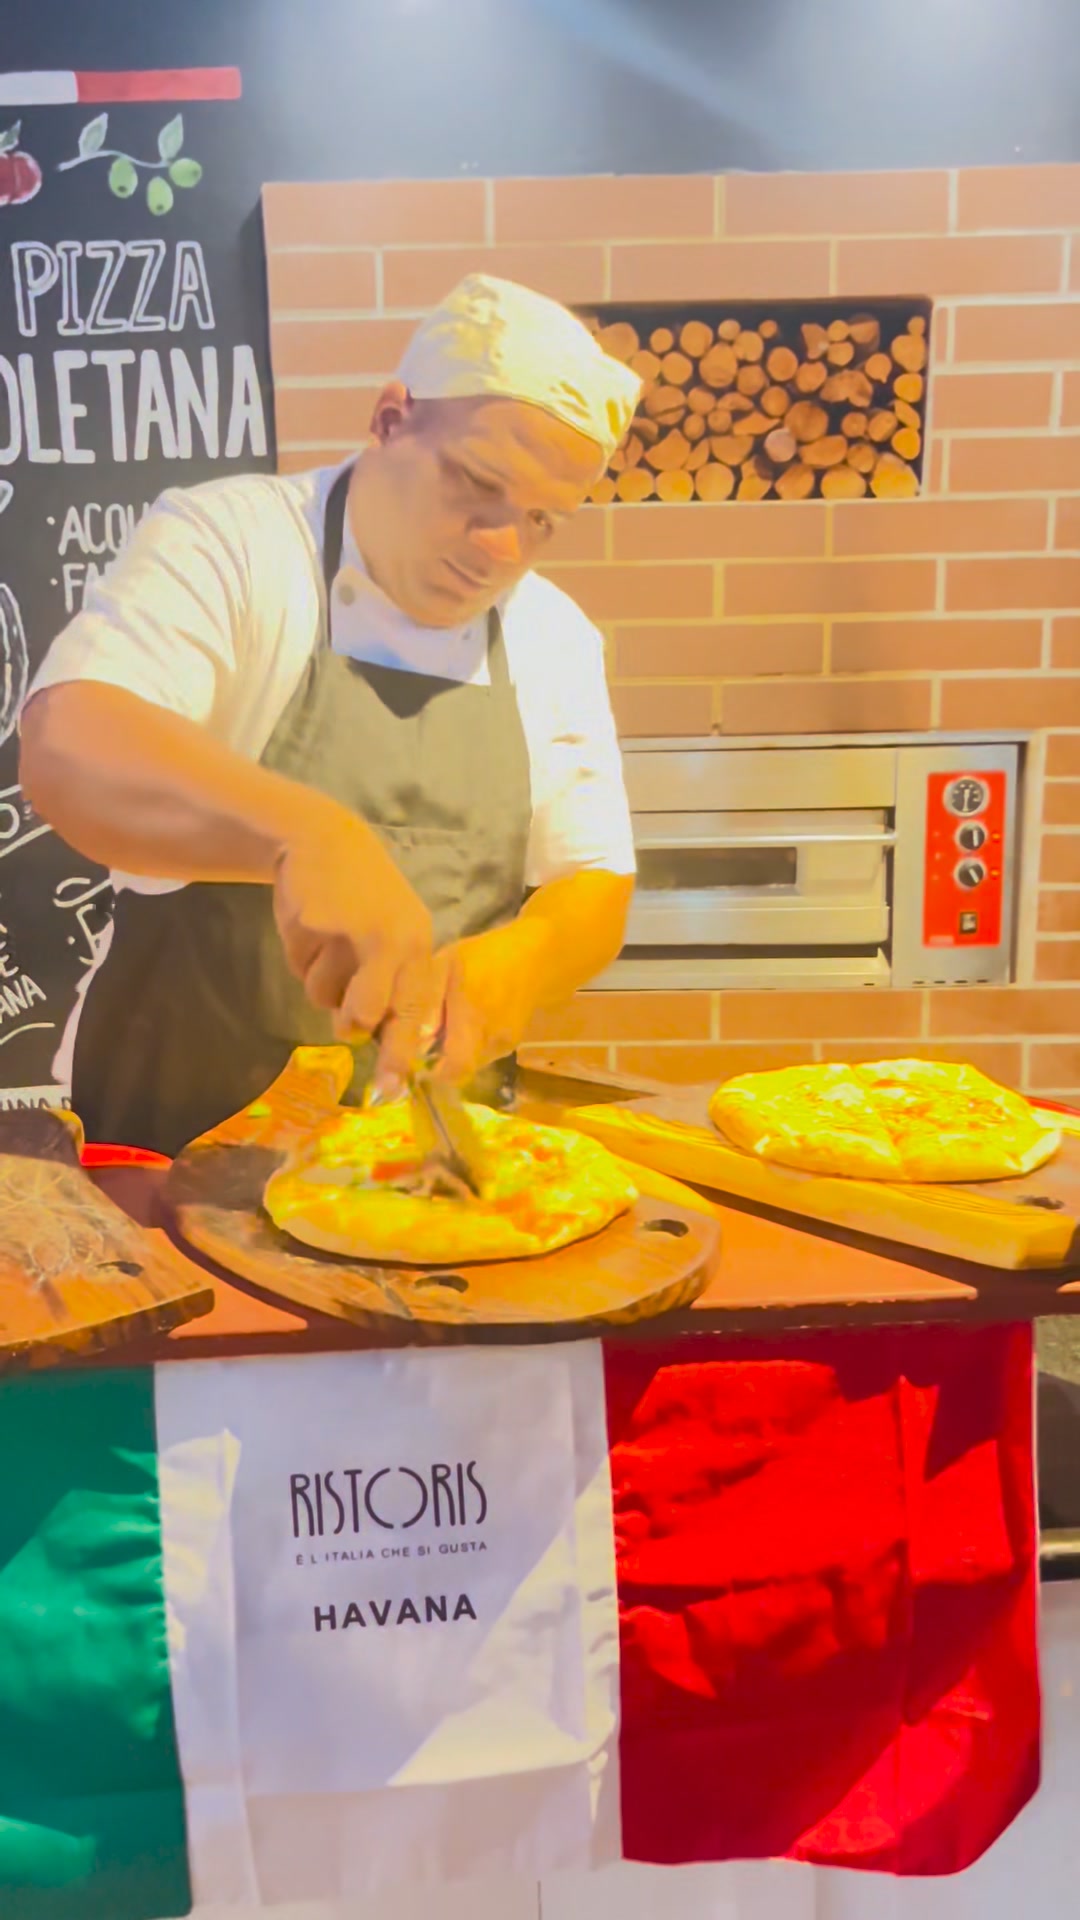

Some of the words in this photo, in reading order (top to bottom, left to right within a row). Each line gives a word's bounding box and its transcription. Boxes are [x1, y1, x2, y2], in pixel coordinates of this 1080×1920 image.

[11, 239, 216, 338] PIZZA
[290, 1460, 488, 1538] RISTORIS
[381, 1547, 411, 1559] CHE
[417, 1545, 431, 1556] SI
[438, 1541, 488, 1555] GUSTA
[314, 1593, 477, 1632] HAVANA
